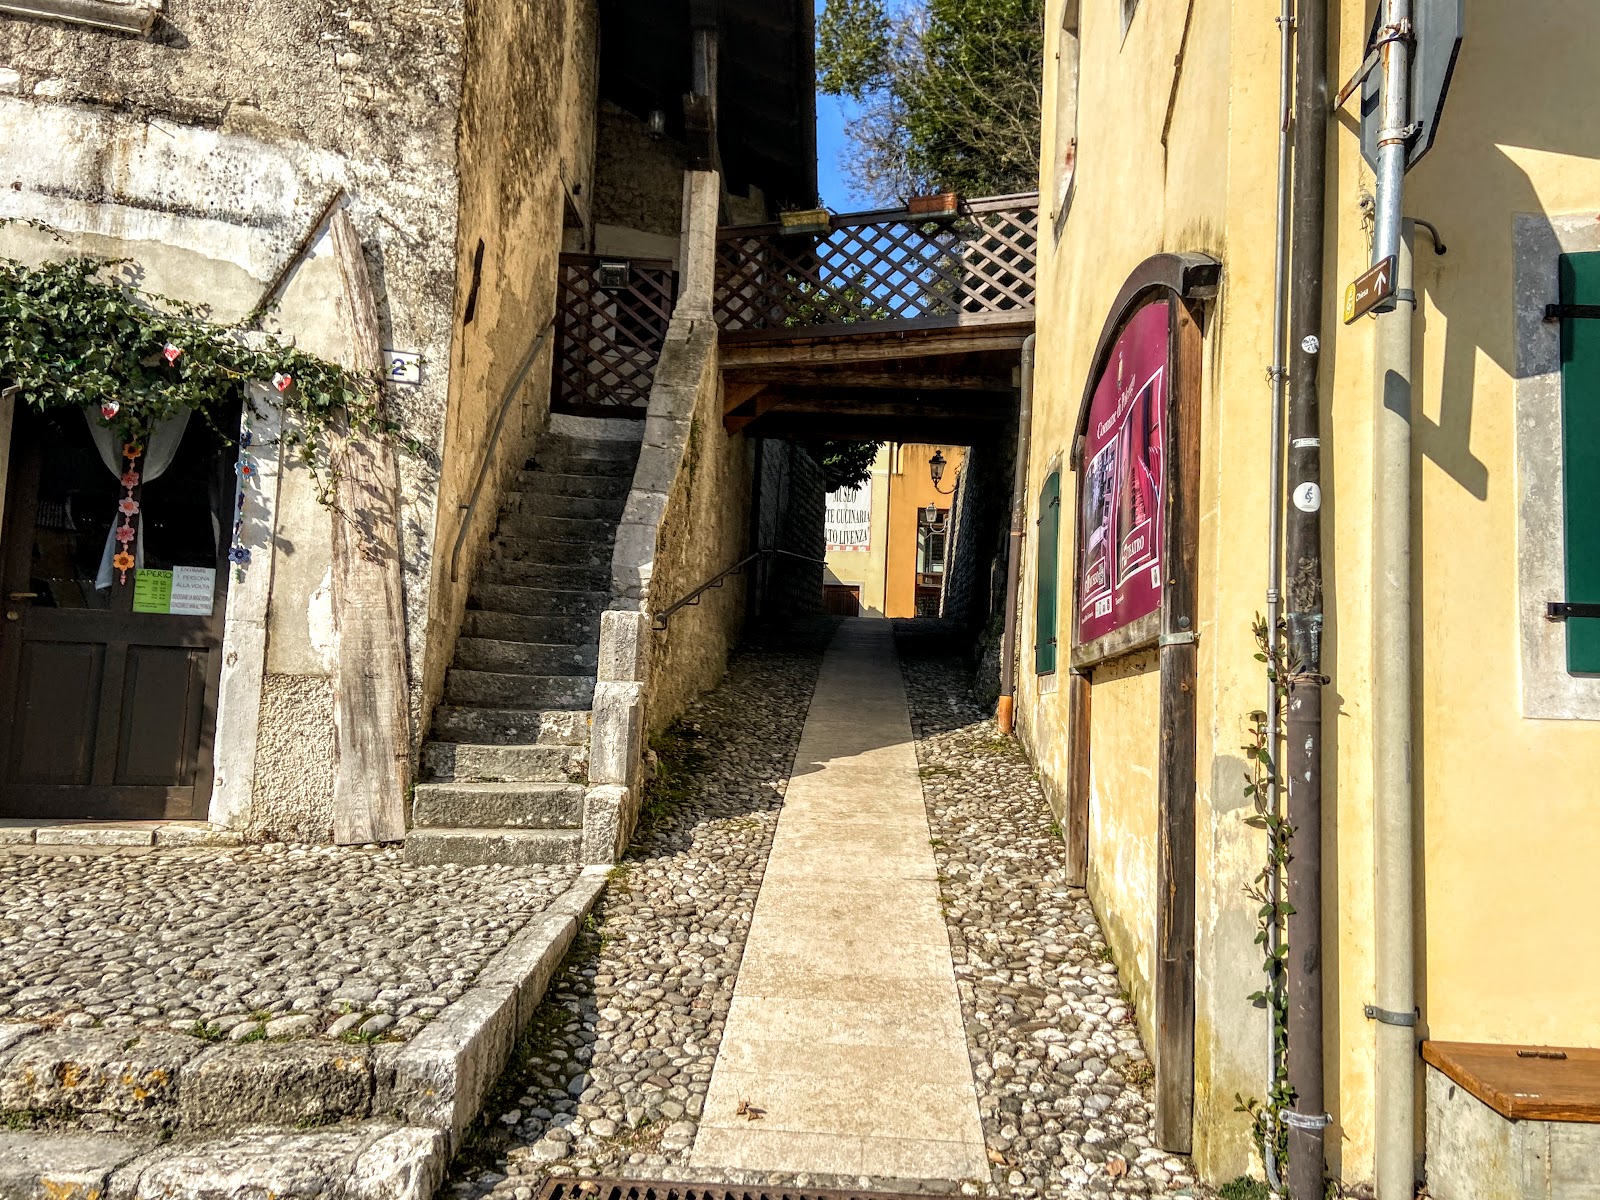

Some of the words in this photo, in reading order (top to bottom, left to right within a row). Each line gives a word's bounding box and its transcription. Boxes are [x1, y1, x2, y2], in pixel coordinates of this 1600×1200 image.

[392, 358, 405, 376] 2
[825, 508, 835, 523] TE
[139, 570, 173, 579] APERTO
